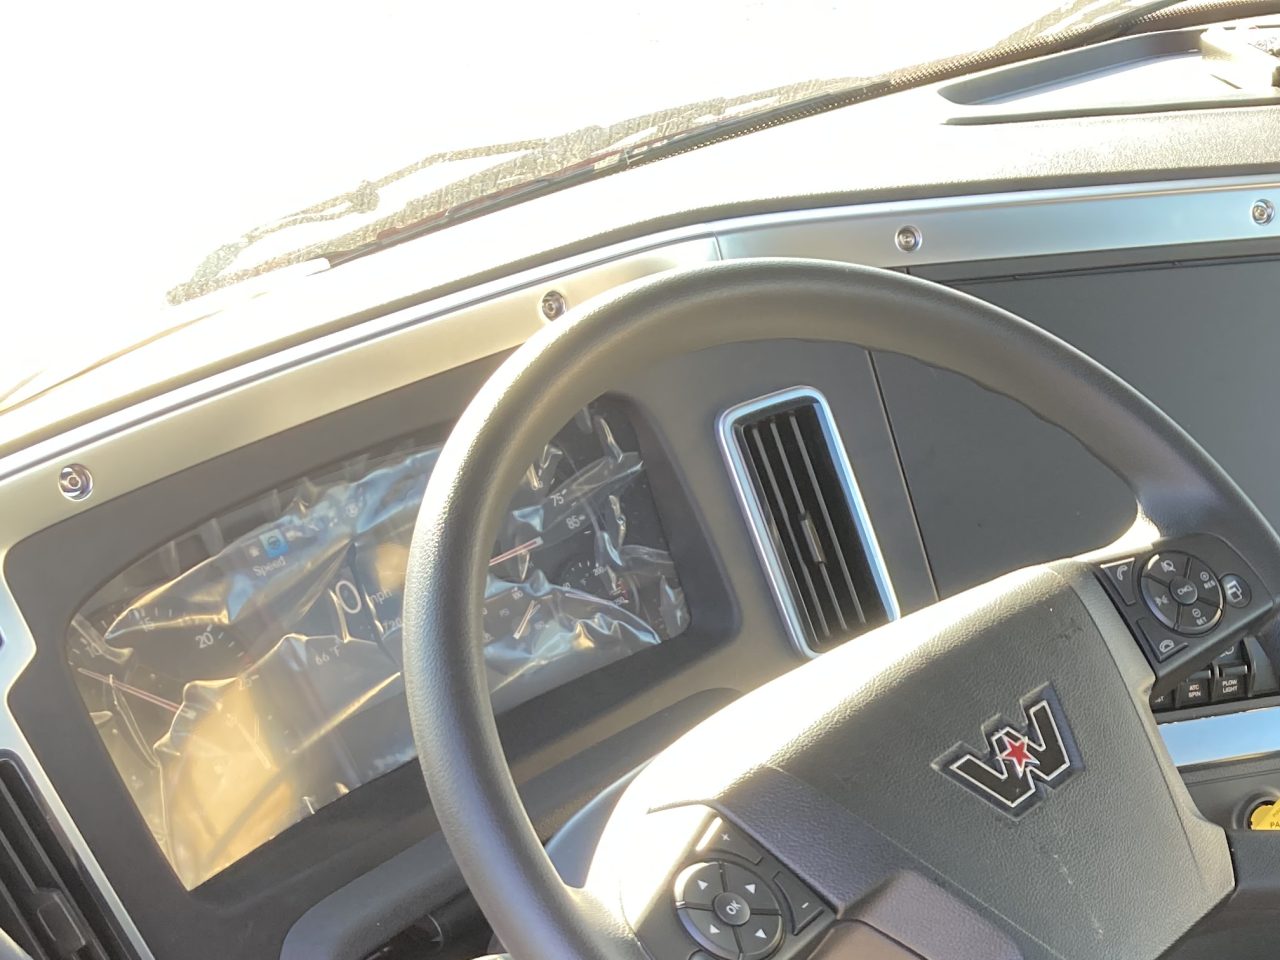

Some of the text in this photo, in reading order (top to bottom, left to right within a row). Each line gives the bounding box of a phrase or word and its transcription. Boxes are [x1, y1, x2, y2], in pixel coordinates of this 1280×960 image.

[550, 493, 564, 507] 75
[566, 515, 580, 529] 85
[253, 556, 286, 577] Speed
[336, 580, 361, 613] 0
[195, 632, 214, 648] 20
[725, 901, 742, 915] OK
